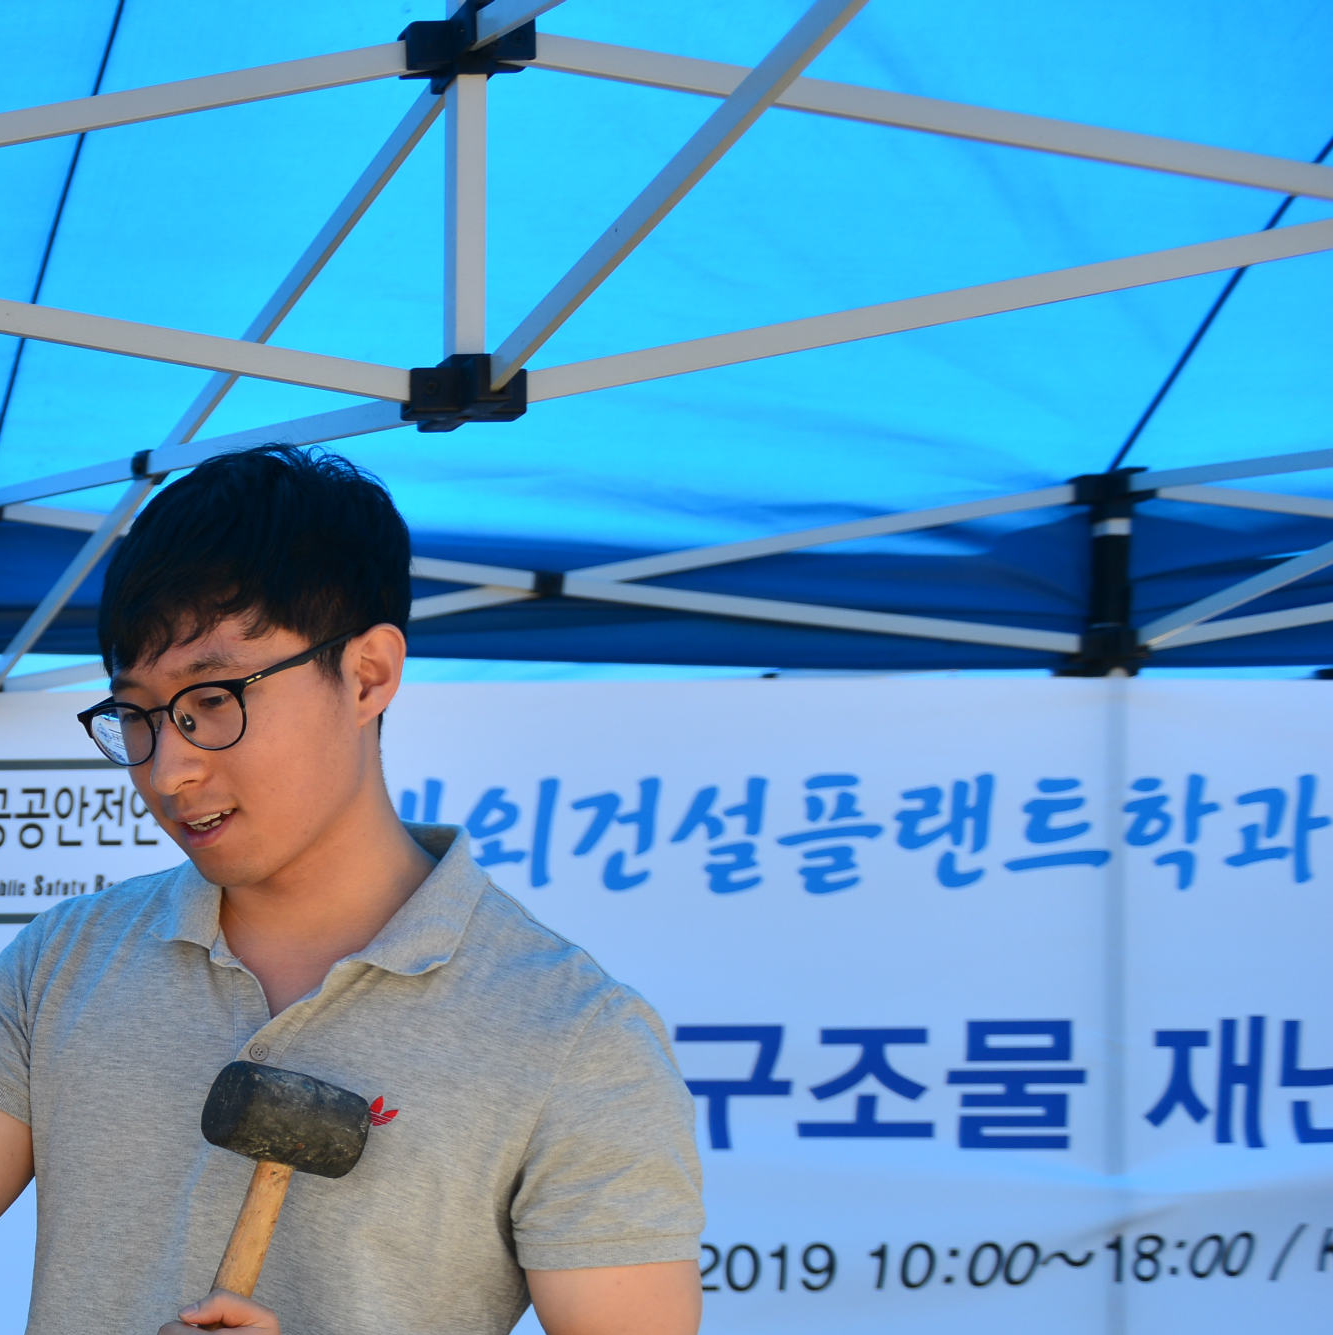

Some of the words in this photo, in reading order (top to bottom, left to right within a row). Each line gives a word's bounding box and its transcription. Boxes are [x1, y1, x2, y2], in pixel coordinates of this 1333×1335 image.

[34, 874, 87, 897] Safety
[675, 1020, 1087, 1150] 구조물
[701, 1242, 836, 1292] 2019
[870, 1231, 1255, 1290] 10:00~18:00
